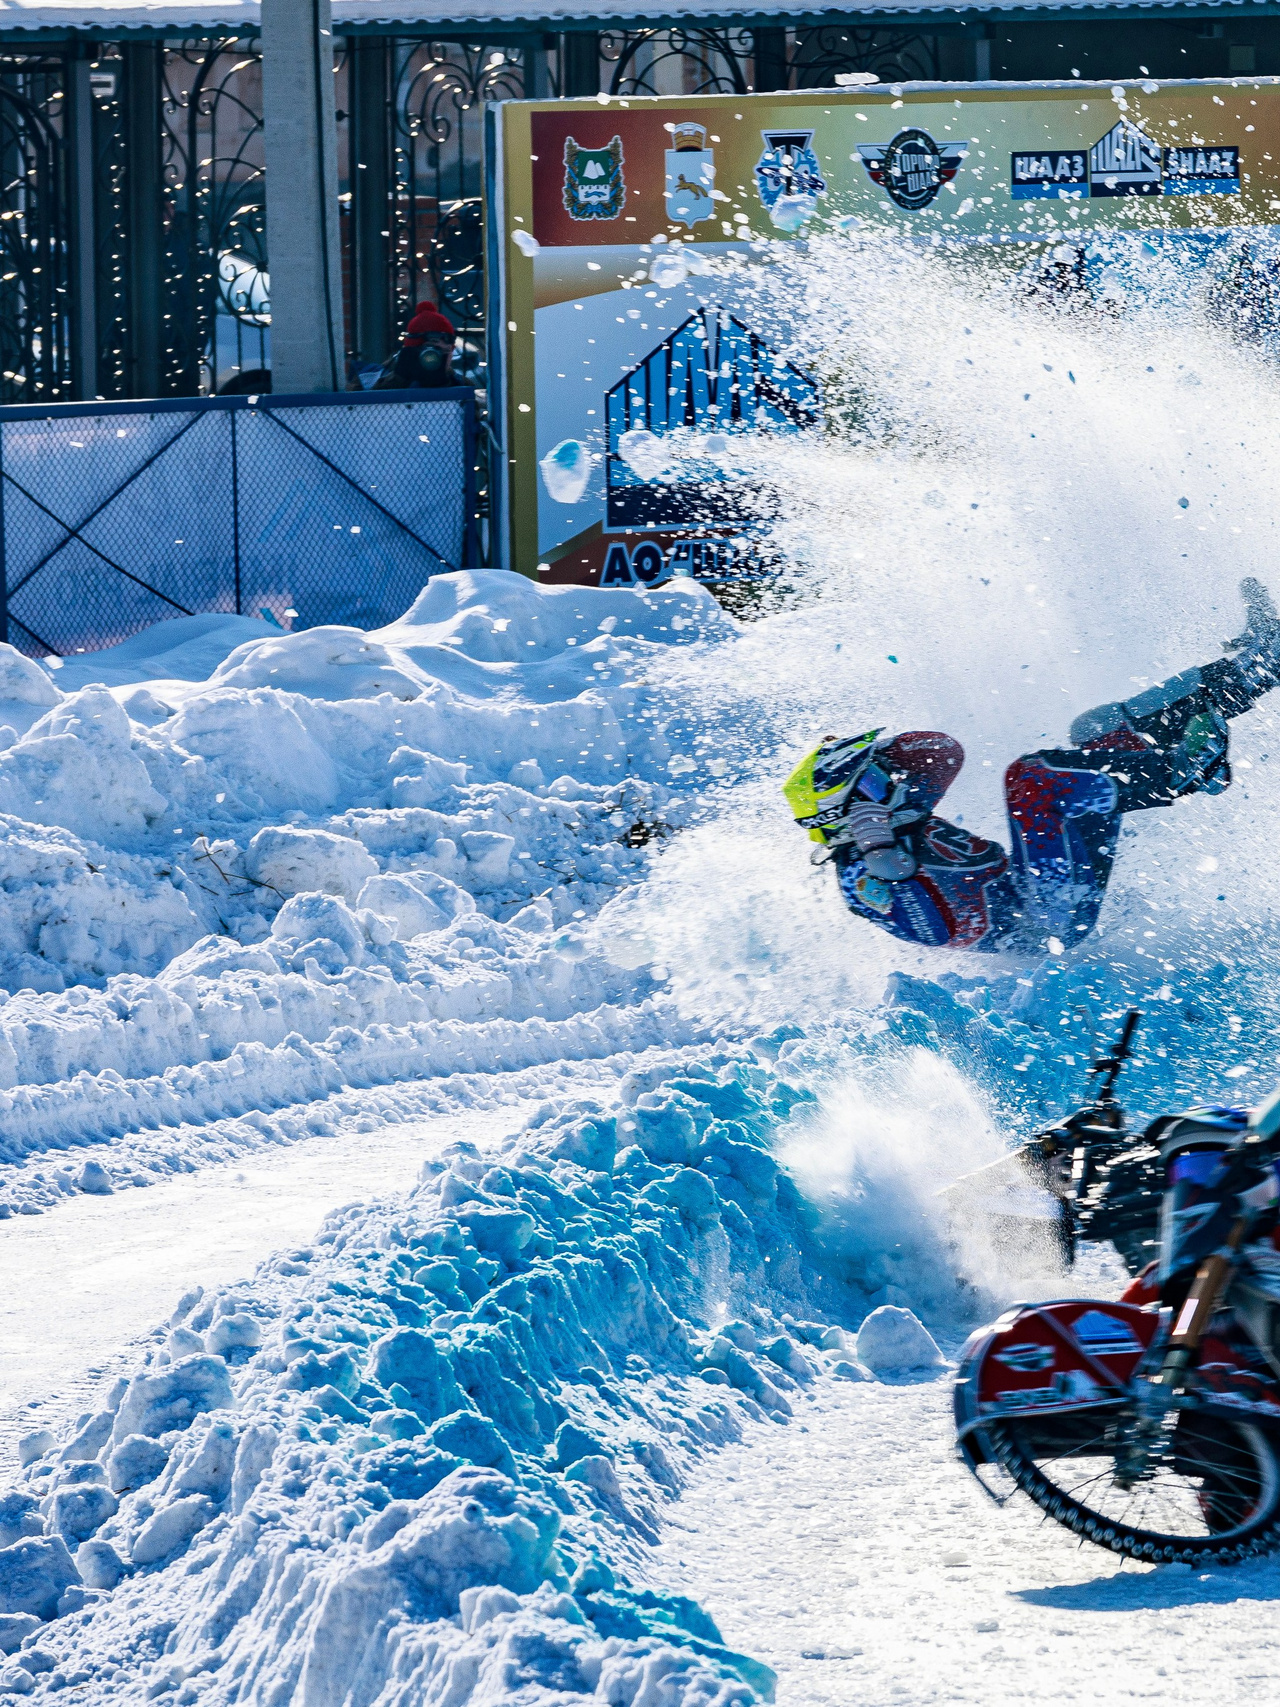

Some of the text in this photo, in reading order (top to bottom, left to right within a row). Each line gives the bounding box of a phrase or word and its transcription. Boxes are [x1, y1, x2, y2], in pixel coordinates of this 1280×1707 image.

[1014, 155, 1085, 179] ШААЗ
[1168, 151, 1235, 175] SHAAZ
[603, 545, 661, 583] АО
